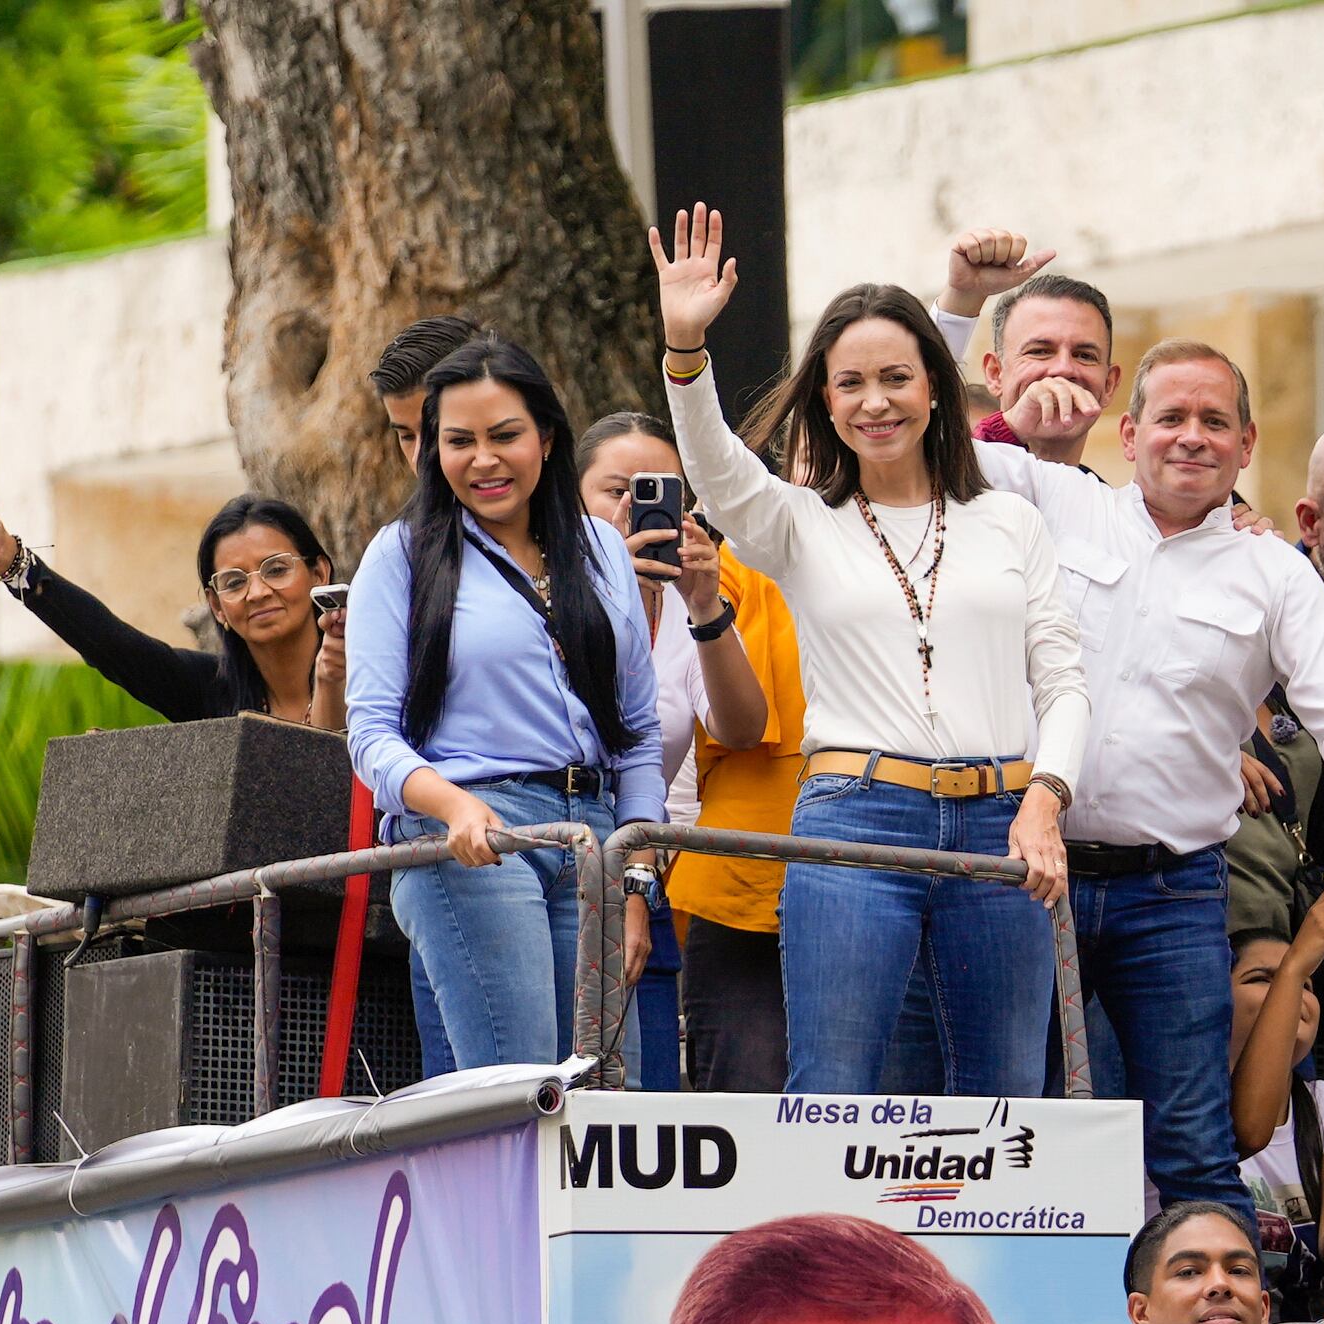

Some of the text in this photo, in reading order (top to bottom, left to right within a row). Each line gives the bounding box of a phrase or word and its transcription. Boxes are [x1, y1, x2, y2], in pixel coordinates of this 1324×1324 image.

[776, 1096, 933, 1125] Mesa de la
[560, 1123, 738, 1190] MUD
[843, 1144, 996, 1181] Unidad
[916, 1204, 1086, 1230] Democrática
